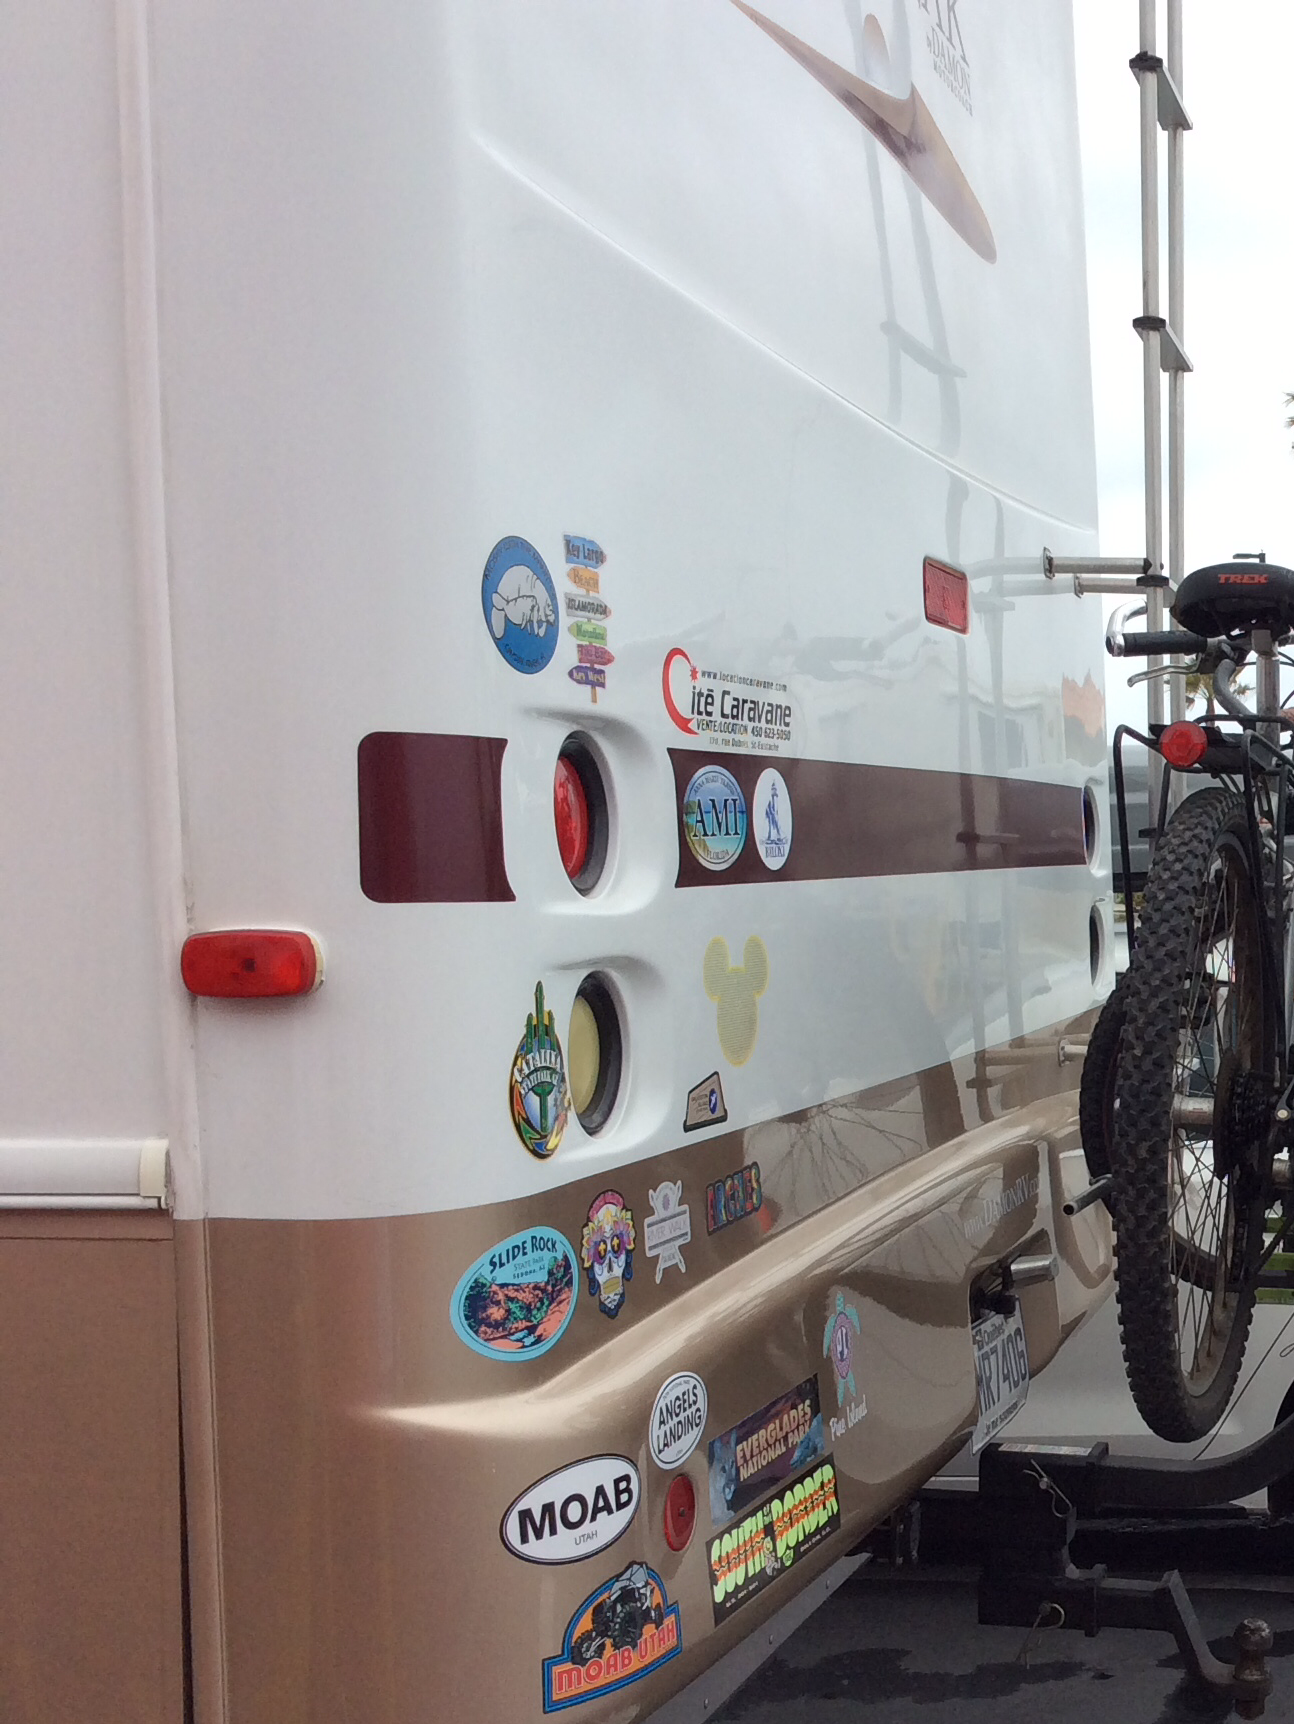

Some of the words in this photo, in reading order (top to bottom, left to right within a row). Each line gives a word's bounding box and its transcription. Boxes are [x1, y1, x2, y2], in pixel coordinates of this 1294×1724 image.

[931, 26, 971, 101] DAMON
[1218, 574, 1268, 584] TREK
[701, 669, 788, 692] www.locationcaravane.com
[720, 689, 791, 727] Caravane
[692, 798, 741, 837] AMI
[706, 1163, 762, 1234] ARCHES
[488, 1240, 528, 1275] SLIDE
[531, 1235, 557, 1254] ROCK
[657, 1407, 702, 1455] LANDING
[658, 1384, 698, 1430] ANGELS
[736, 1399, 812, 1467] EVERGLADES
[740, 1439, 786, 1482] NATIONAL
[788, 1420, 810, 1448] PARK
[518, 1473, 634, 1546] MOAB
[711, 1510, 766, 1603] SOUTH
[771, 1463, 839, 1558] BORDER
[574, 1529, 598, 1546] UTAH
[555, 1645, 634, 1694] MOAB
[637, 1619, 677, 1662] UTAH
